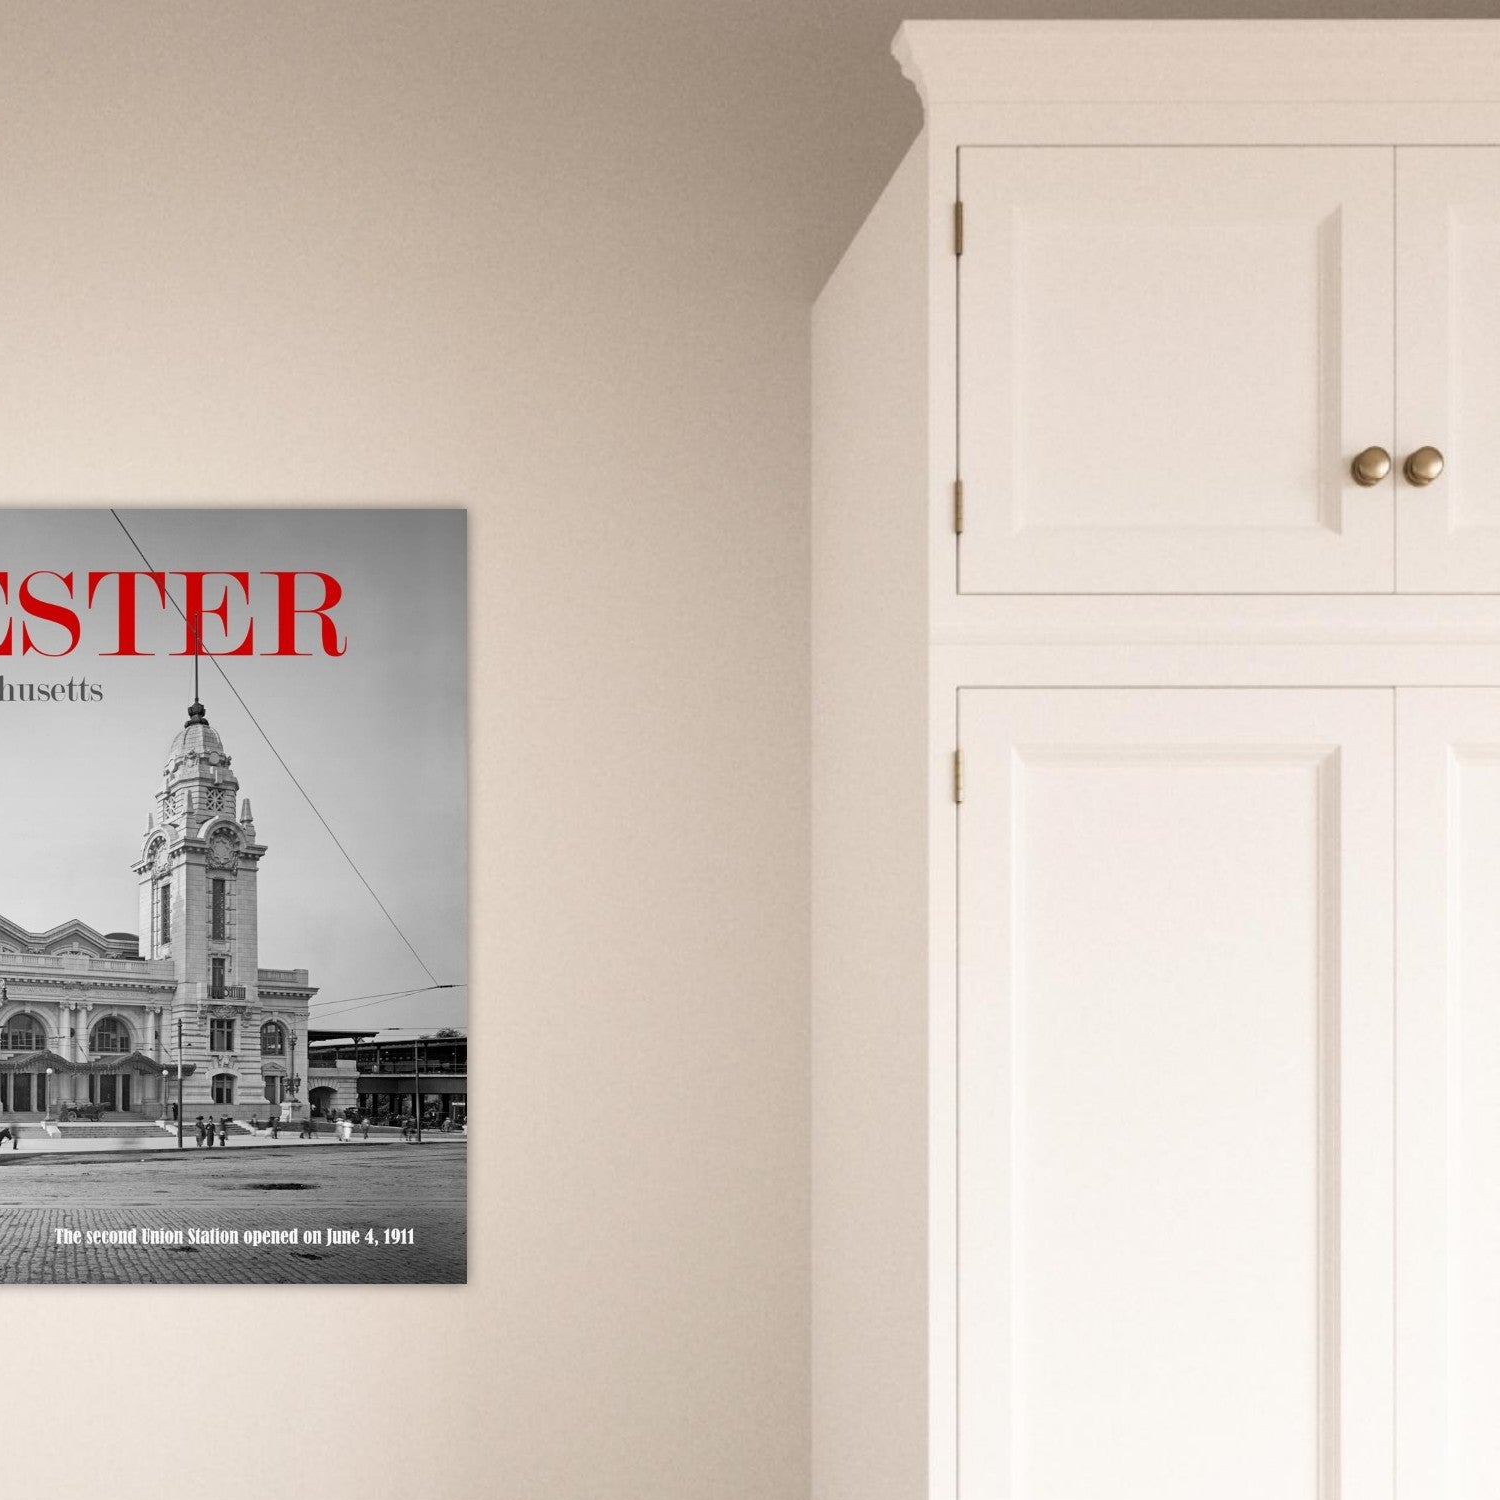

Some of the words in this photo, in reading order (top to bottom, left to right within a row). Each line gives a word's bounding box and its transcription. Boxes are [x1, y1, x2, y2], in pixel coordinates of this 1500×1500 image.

[54, 1228, 82, 1245] The
[86, 1228, 137, 1245] second
[141, 1228, 183, 1245] Union
[188, 1228, 239, 1245] Station
[243, 1228, 298, 1247] opened
[303, 1230, 322, 1245] on
[326, 1228, 360, 1247] June
[364, 1228, 379, 1247] 4,
[384, 1228, 414, 1245] 1911
